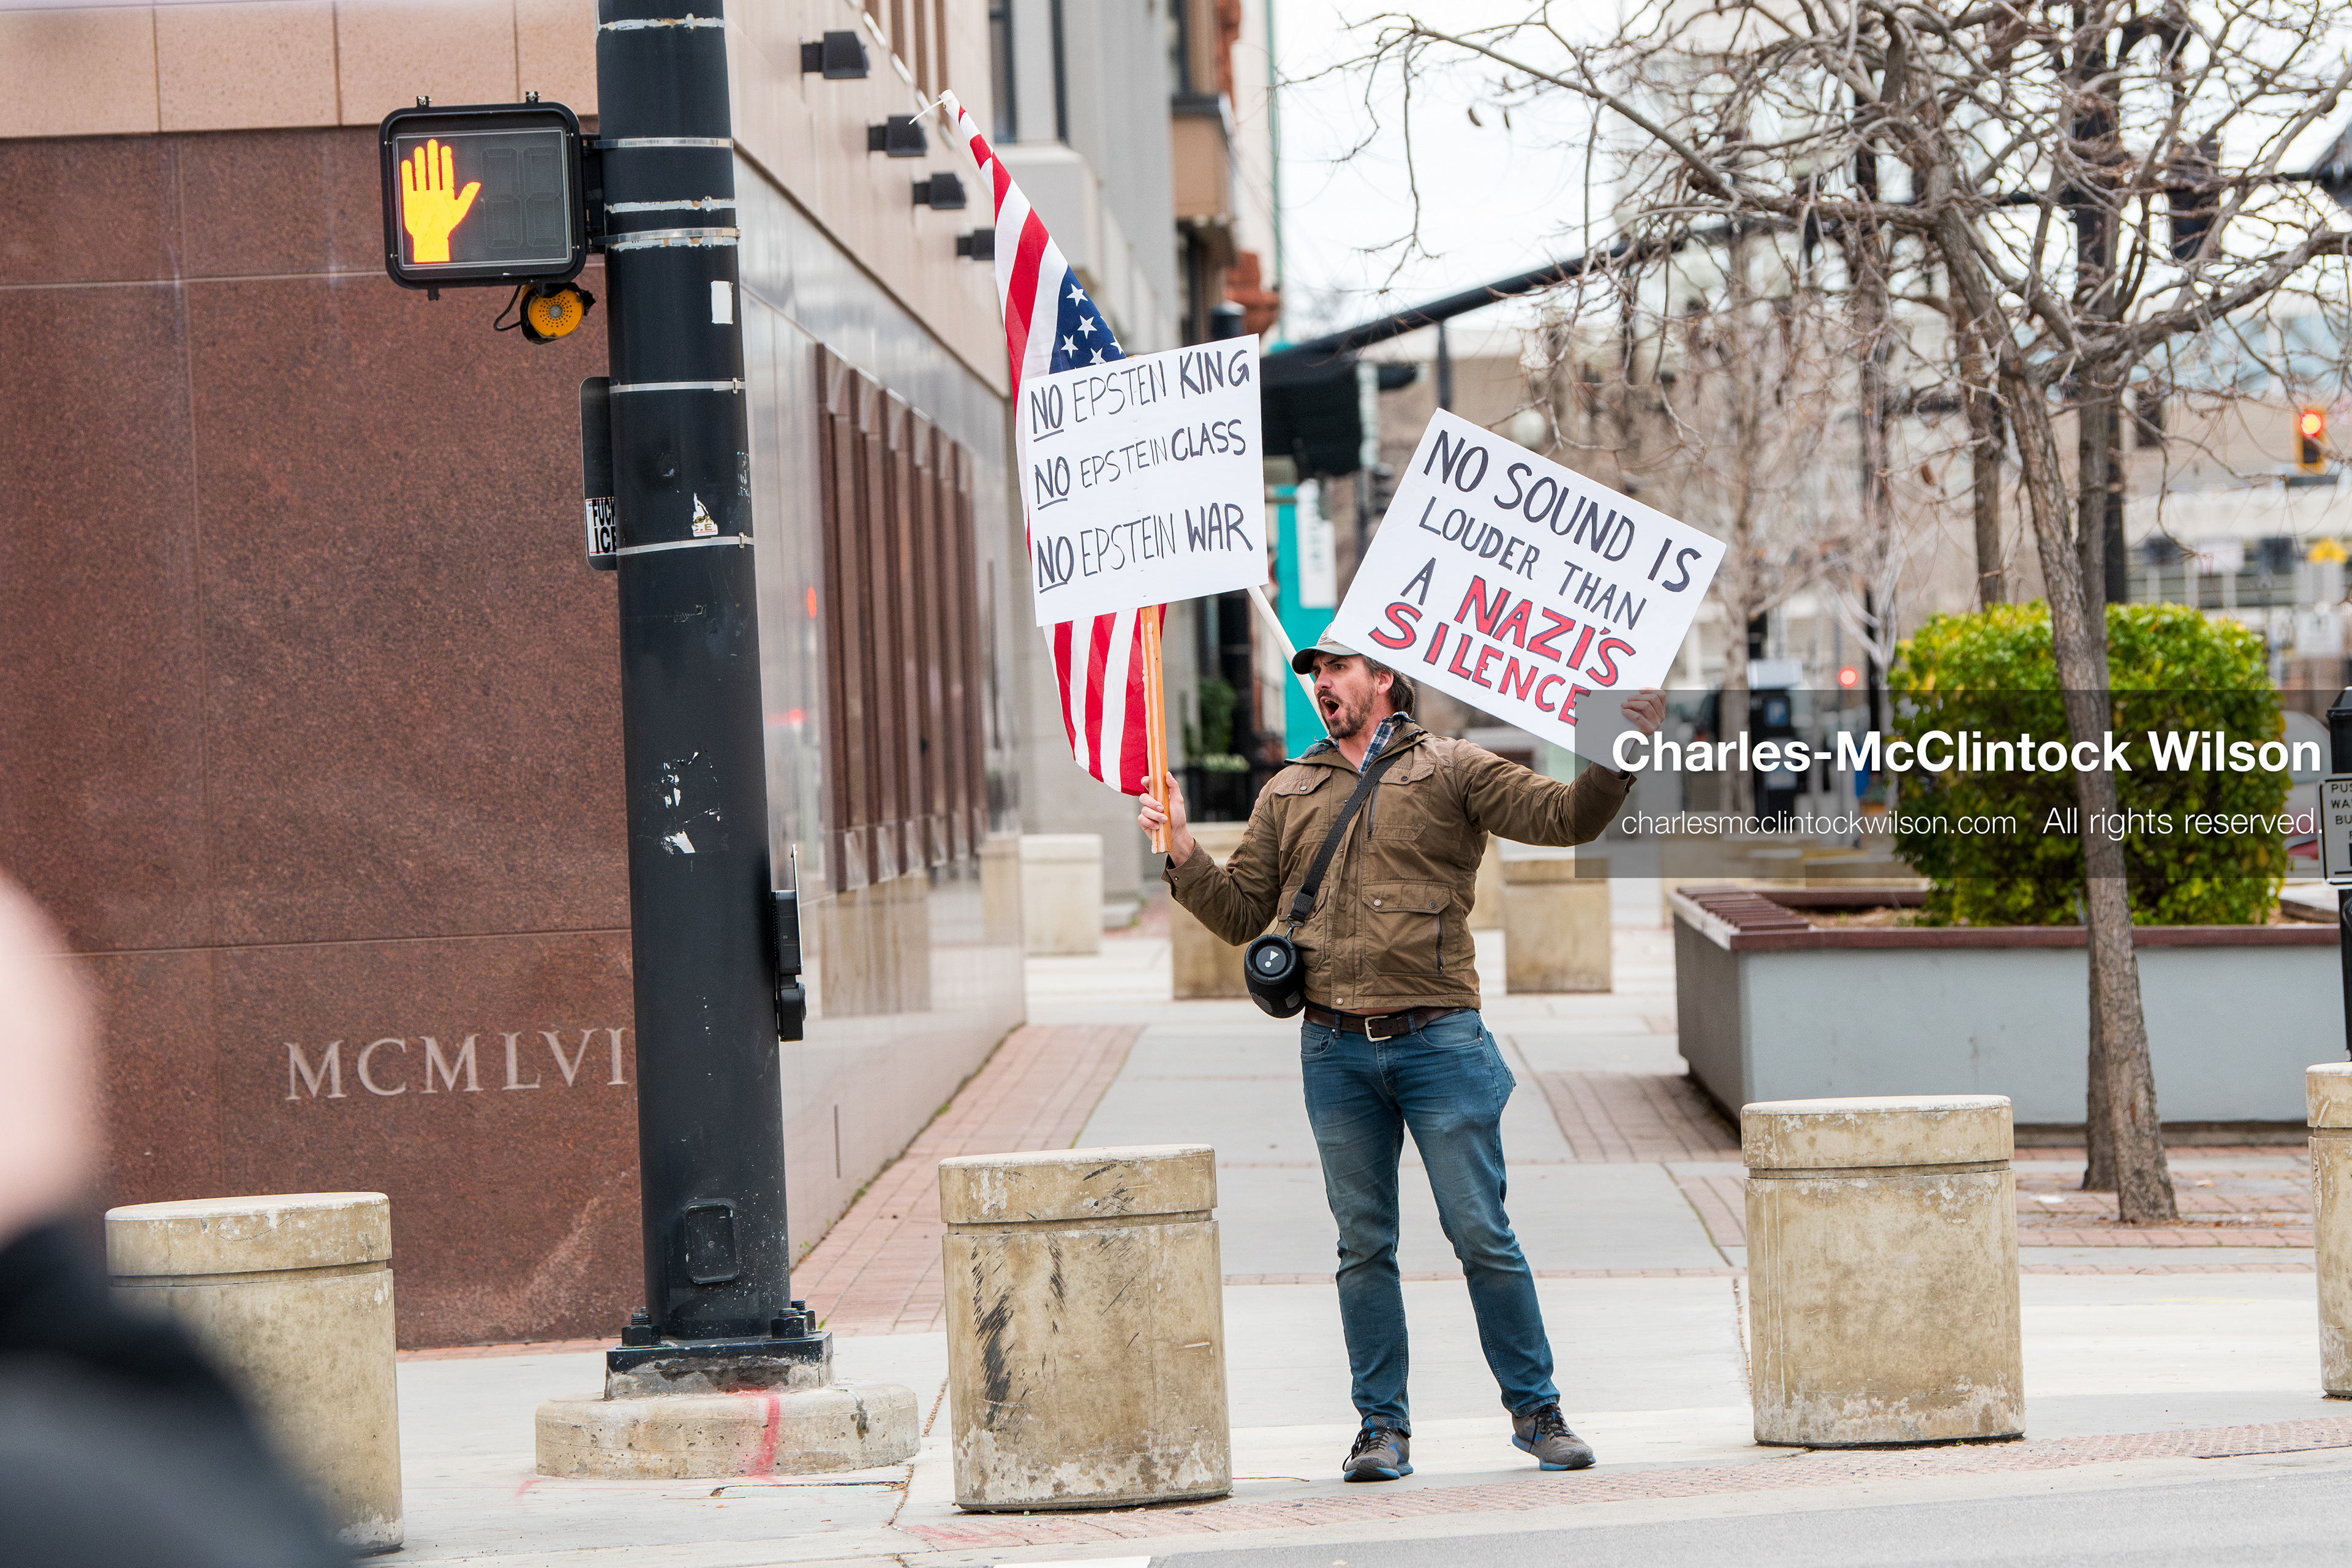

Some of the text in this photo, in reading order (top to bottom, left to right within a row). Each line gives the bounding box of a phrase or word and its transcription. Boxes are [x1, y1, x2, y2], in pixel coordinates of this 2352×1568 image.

[1031, 384, 1063, 434] NO
[1180, 349, 1250, 399] KING
[1035, 419, 1246, 504] NO EPSTEIN CLASS
[1423, 429, 1702, 593] NO SOUND IS
[1037, 536, 1074, 587] NO
[1080, 513, 1175, 577] EPSTEIN
[1185, 502, 1253, 552] WAR
[1419, 496, 1540, 580] LOUDER
[1558, 560, 1646, 630] THAN
[1368, 601, 1591, 727] SILENCE
[1400, 557, 1636, 688] A NAZI'S
[283, 1027, 628, 1101] MCMLVI
